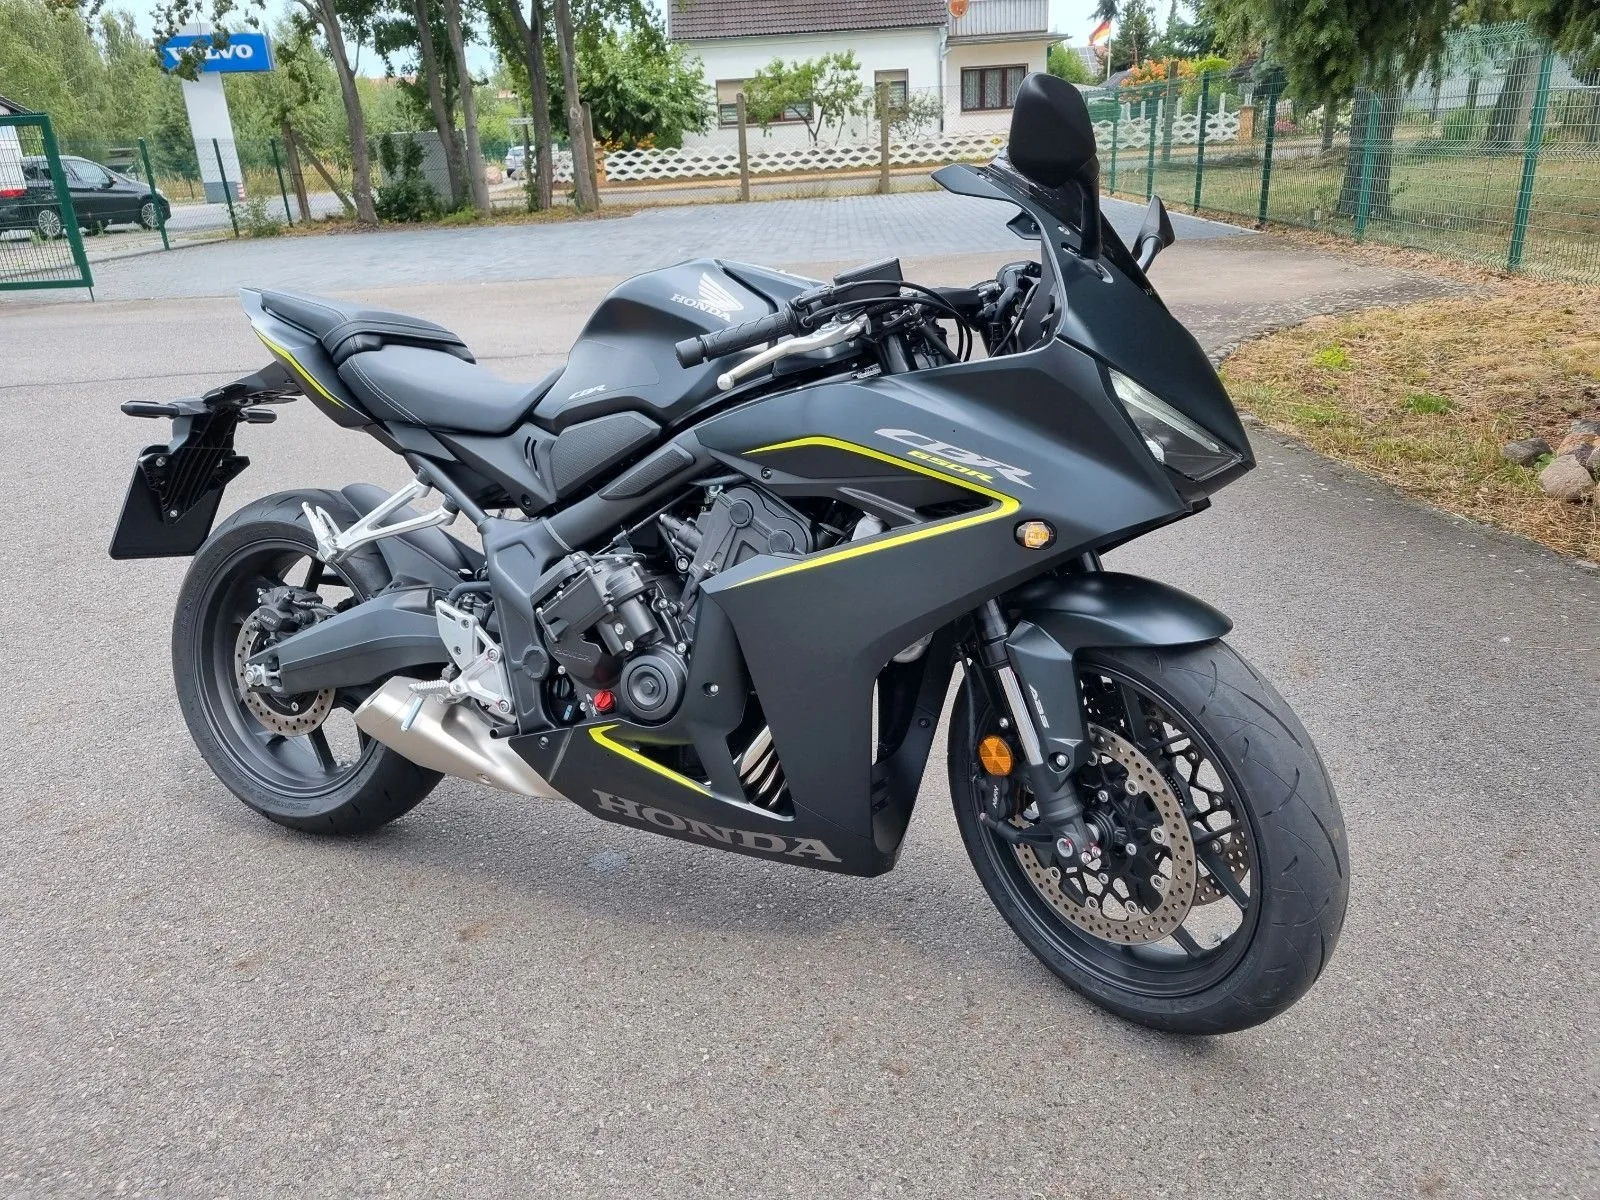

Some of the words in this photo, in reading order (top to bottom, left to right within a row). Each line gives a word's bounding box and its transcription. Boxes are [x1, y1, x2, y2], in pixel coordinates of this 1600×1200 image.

[670, 293, 731, 323] HONDA
[874, 428, 1036, 490] CBR
[907, 450, 993, 484] 650R
[1028, 683, 1050, 729] ABS
[591, 788, 842, 863] HONDA
